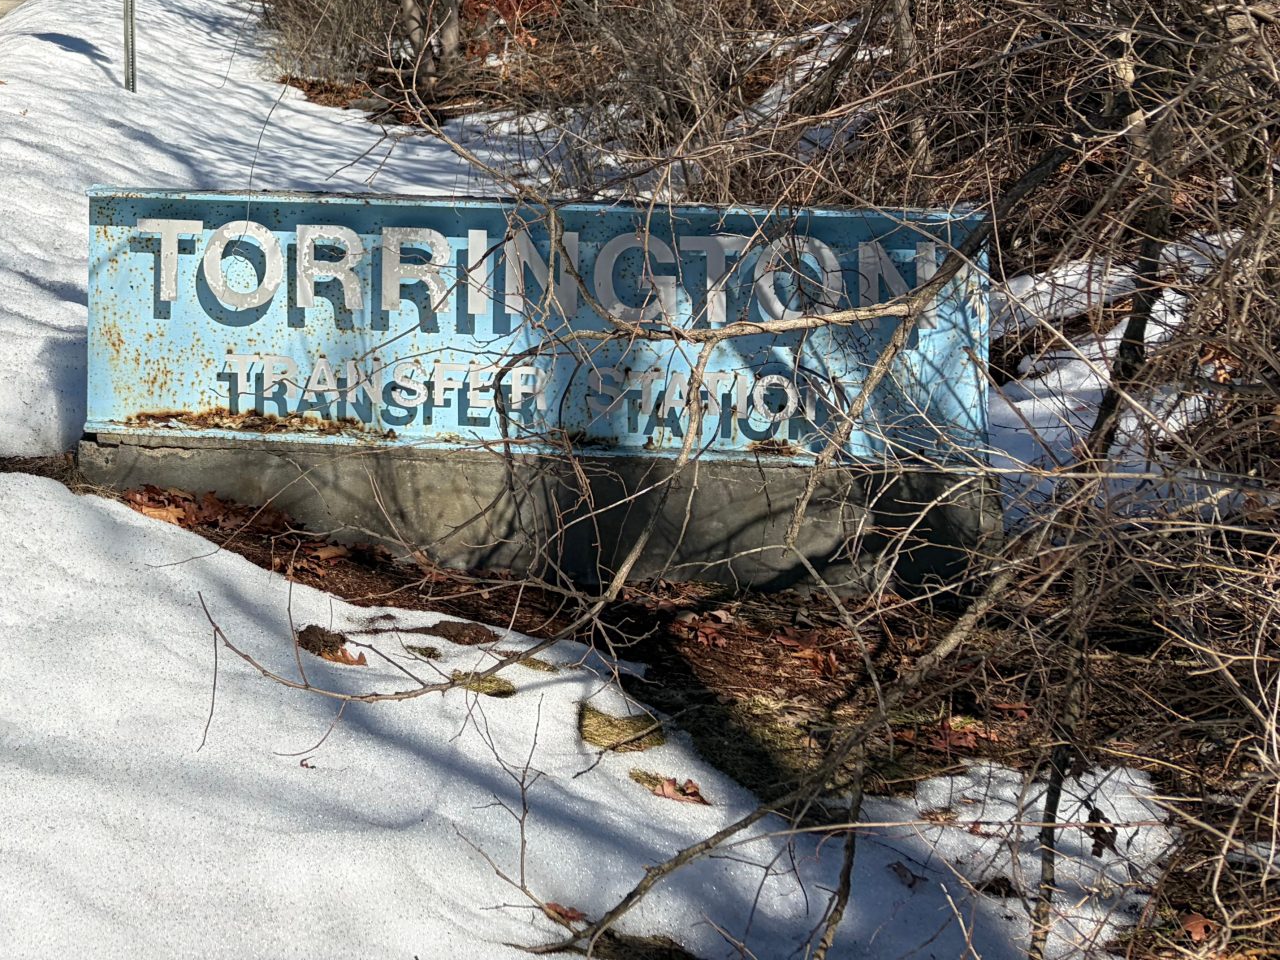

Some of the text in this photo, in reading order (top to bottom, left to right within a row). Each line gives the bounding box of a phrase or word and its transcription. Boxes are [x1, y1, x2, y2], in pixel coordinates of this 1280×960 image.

[136, 218, 937, 331] TORRINGTON
[223, 353, 846, 424] TRANSFER STATION
